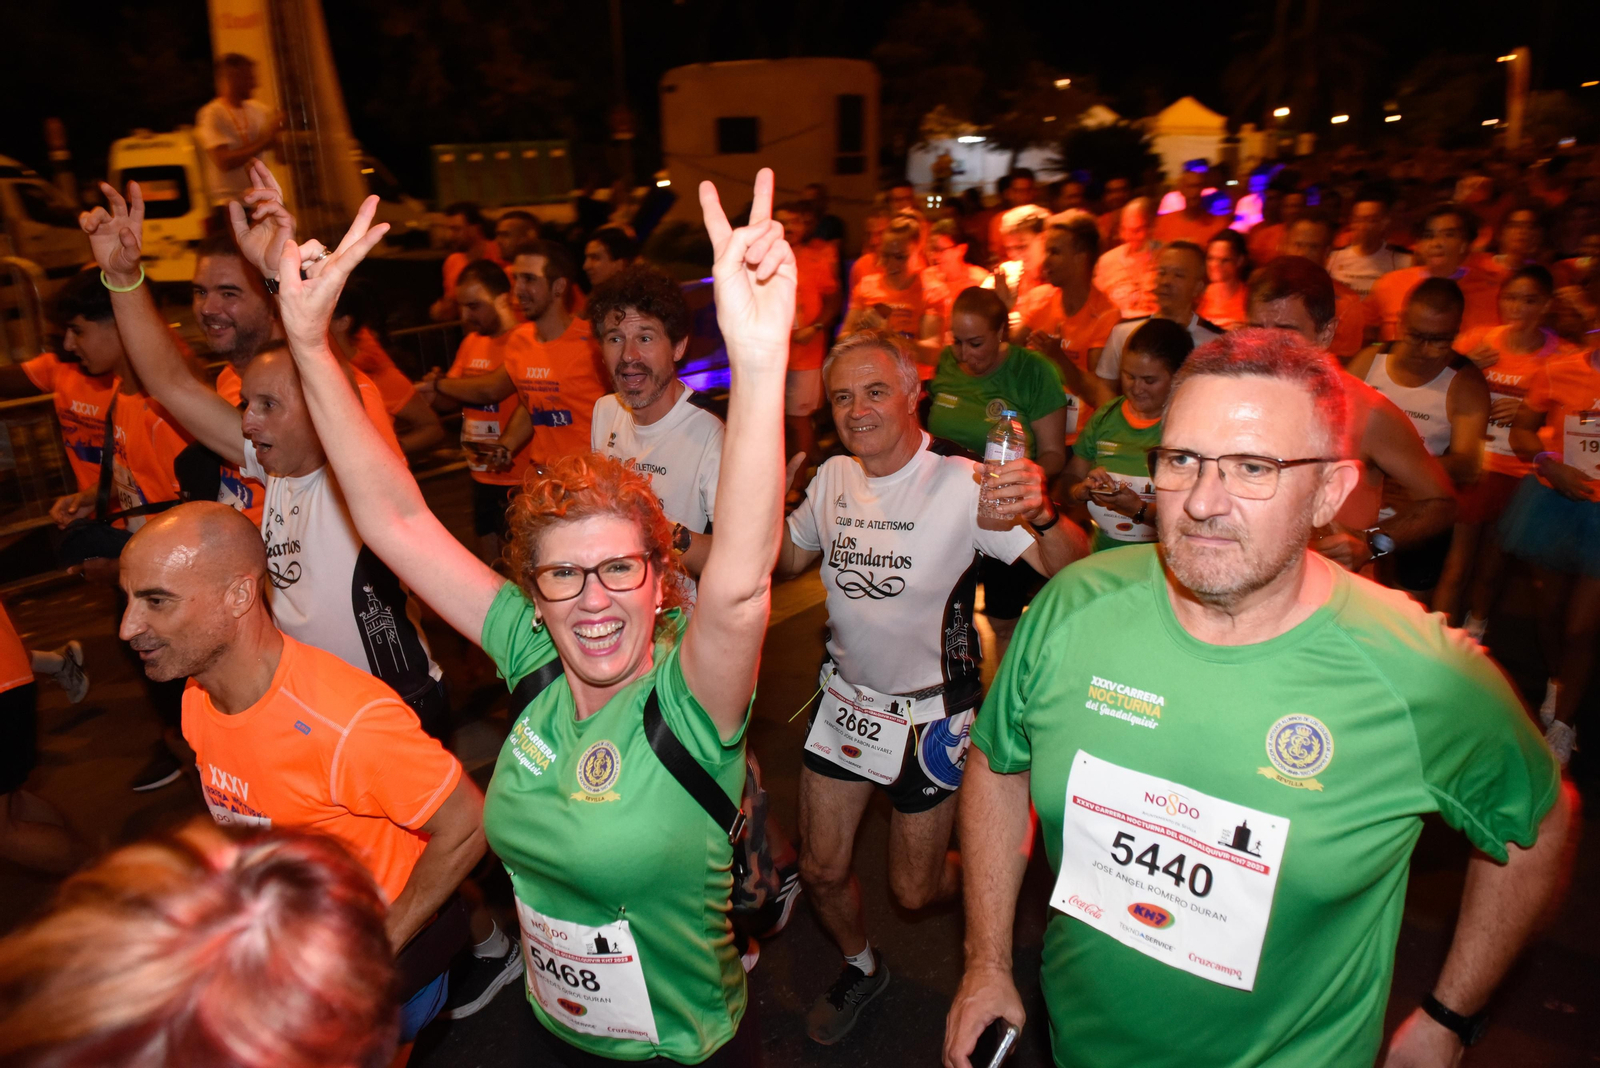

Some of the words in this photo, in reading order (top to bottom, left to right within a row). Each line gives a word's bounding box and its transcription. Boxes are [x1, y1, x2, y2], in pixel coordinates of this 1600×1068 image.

[526, 367, 550, 379] XXXV
[1486, 370, 1523, 386] XXXV
[70, 399, 99, 417] XXXV
[835, 516, 852, 527] CLUB
[855, 519, 864, 528] DE
[867, 520, 915, 531] ATLETISMO
[828, 539, 912, 571] Legendarios
[836, 532, 857, 550] Los
[1088, 685, 1161, 719] NOCTURNA
[1090, 675, 1117, 691] XXXV
[1116, 683, 1165, 706] CARRERA
[835, 707, 882, 741] 2662
[1085, 699, 1099, 711] del
[1099, 703, 1159, 730] Guadalquivir
[514, 723, 551, 771] NTURNA
[524, 726, 557, 763] CARRERA
[871, 744, 893, 755] ALVAREZ
[512, 747, 542, 776] dalquivir
[209, 763, 249, 802] XXXV
[1276, 775, 1304, 787] SEVILLA
[1076, 798, 1095, 810] XXXV
[1095, 804, 1126, 821] CARRERA
[1126, 816, 1165, 834] NOCTURNA
[1165, 829, 1178, 840] DEL
[1179, 834, 1231, 860] GUADALQUIVIR
[1231, 855, 1246, 865] KH7
[1247, 860, 1265, 872] 2023
[1110, 831, 1213, 898] 5440
[1092, 860, 1113, 875] JOSE
[1116, 872, 1145, 890] ANGEL
[1147, 884, 1188, 909] ROMERO
[1190, 903, 1227, 923] DURAN
[530, 945, 601, 992] 5468
[1188, 952, 1242, 977] Cruzcampo
[583, 994, 612, 1003] DURAN
[607, 1026, 649, 1038] Cruzcampo
